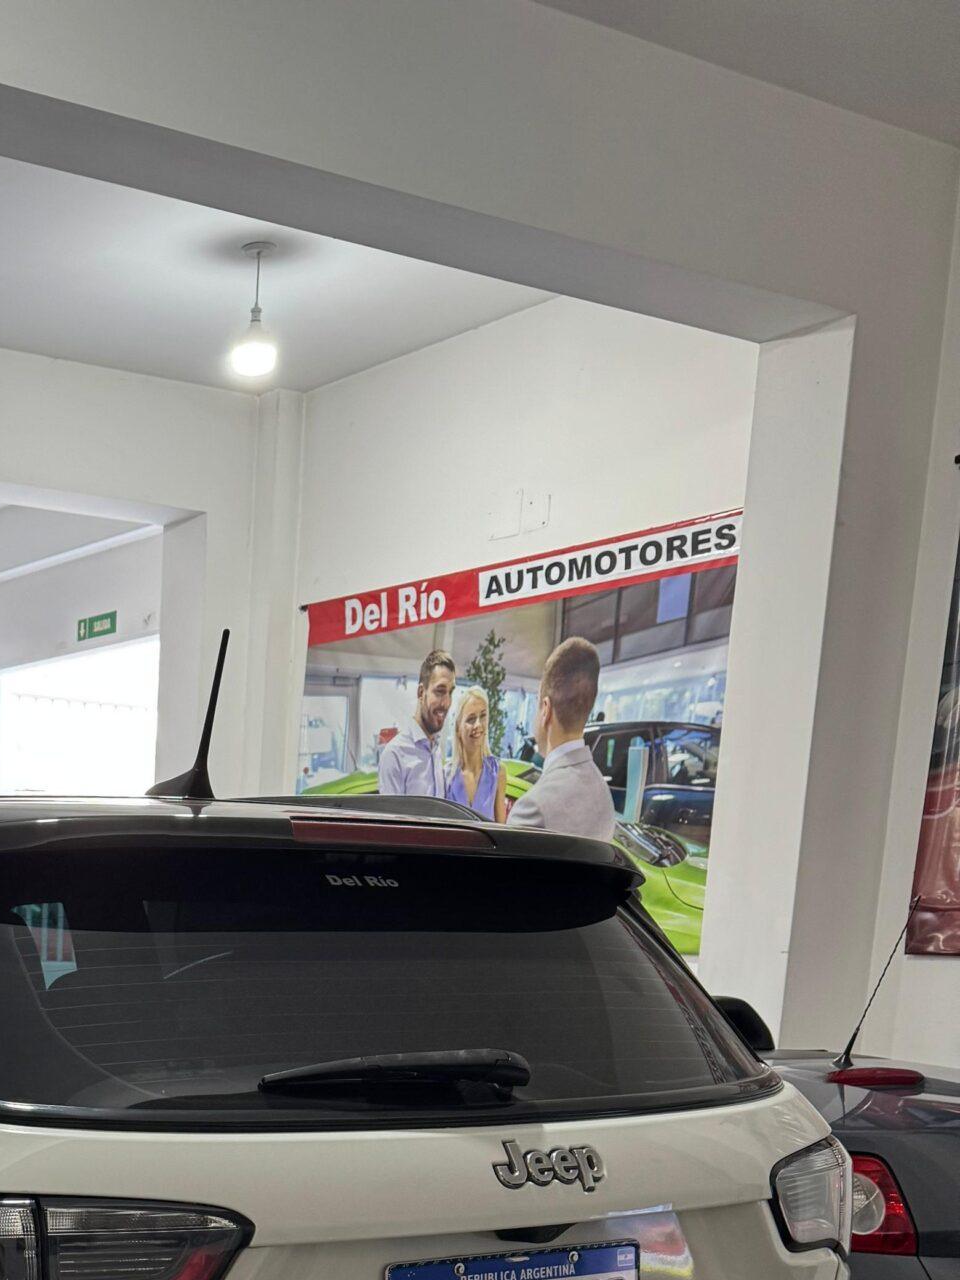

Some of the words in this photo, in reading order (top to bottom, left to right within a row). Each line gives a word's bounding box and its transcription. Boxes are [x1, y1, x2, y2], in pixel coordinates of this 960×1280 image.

[344, 591, 388, 634] Del
[398, 581, 446, 625] Río
[484, 523, 737, 599] AUTOMOTORES
[325, 874, 363, 887] Del
[492, 1138, 605, 1192] Jeep
[520, 1263, 576, 1280] ARGENTINA
